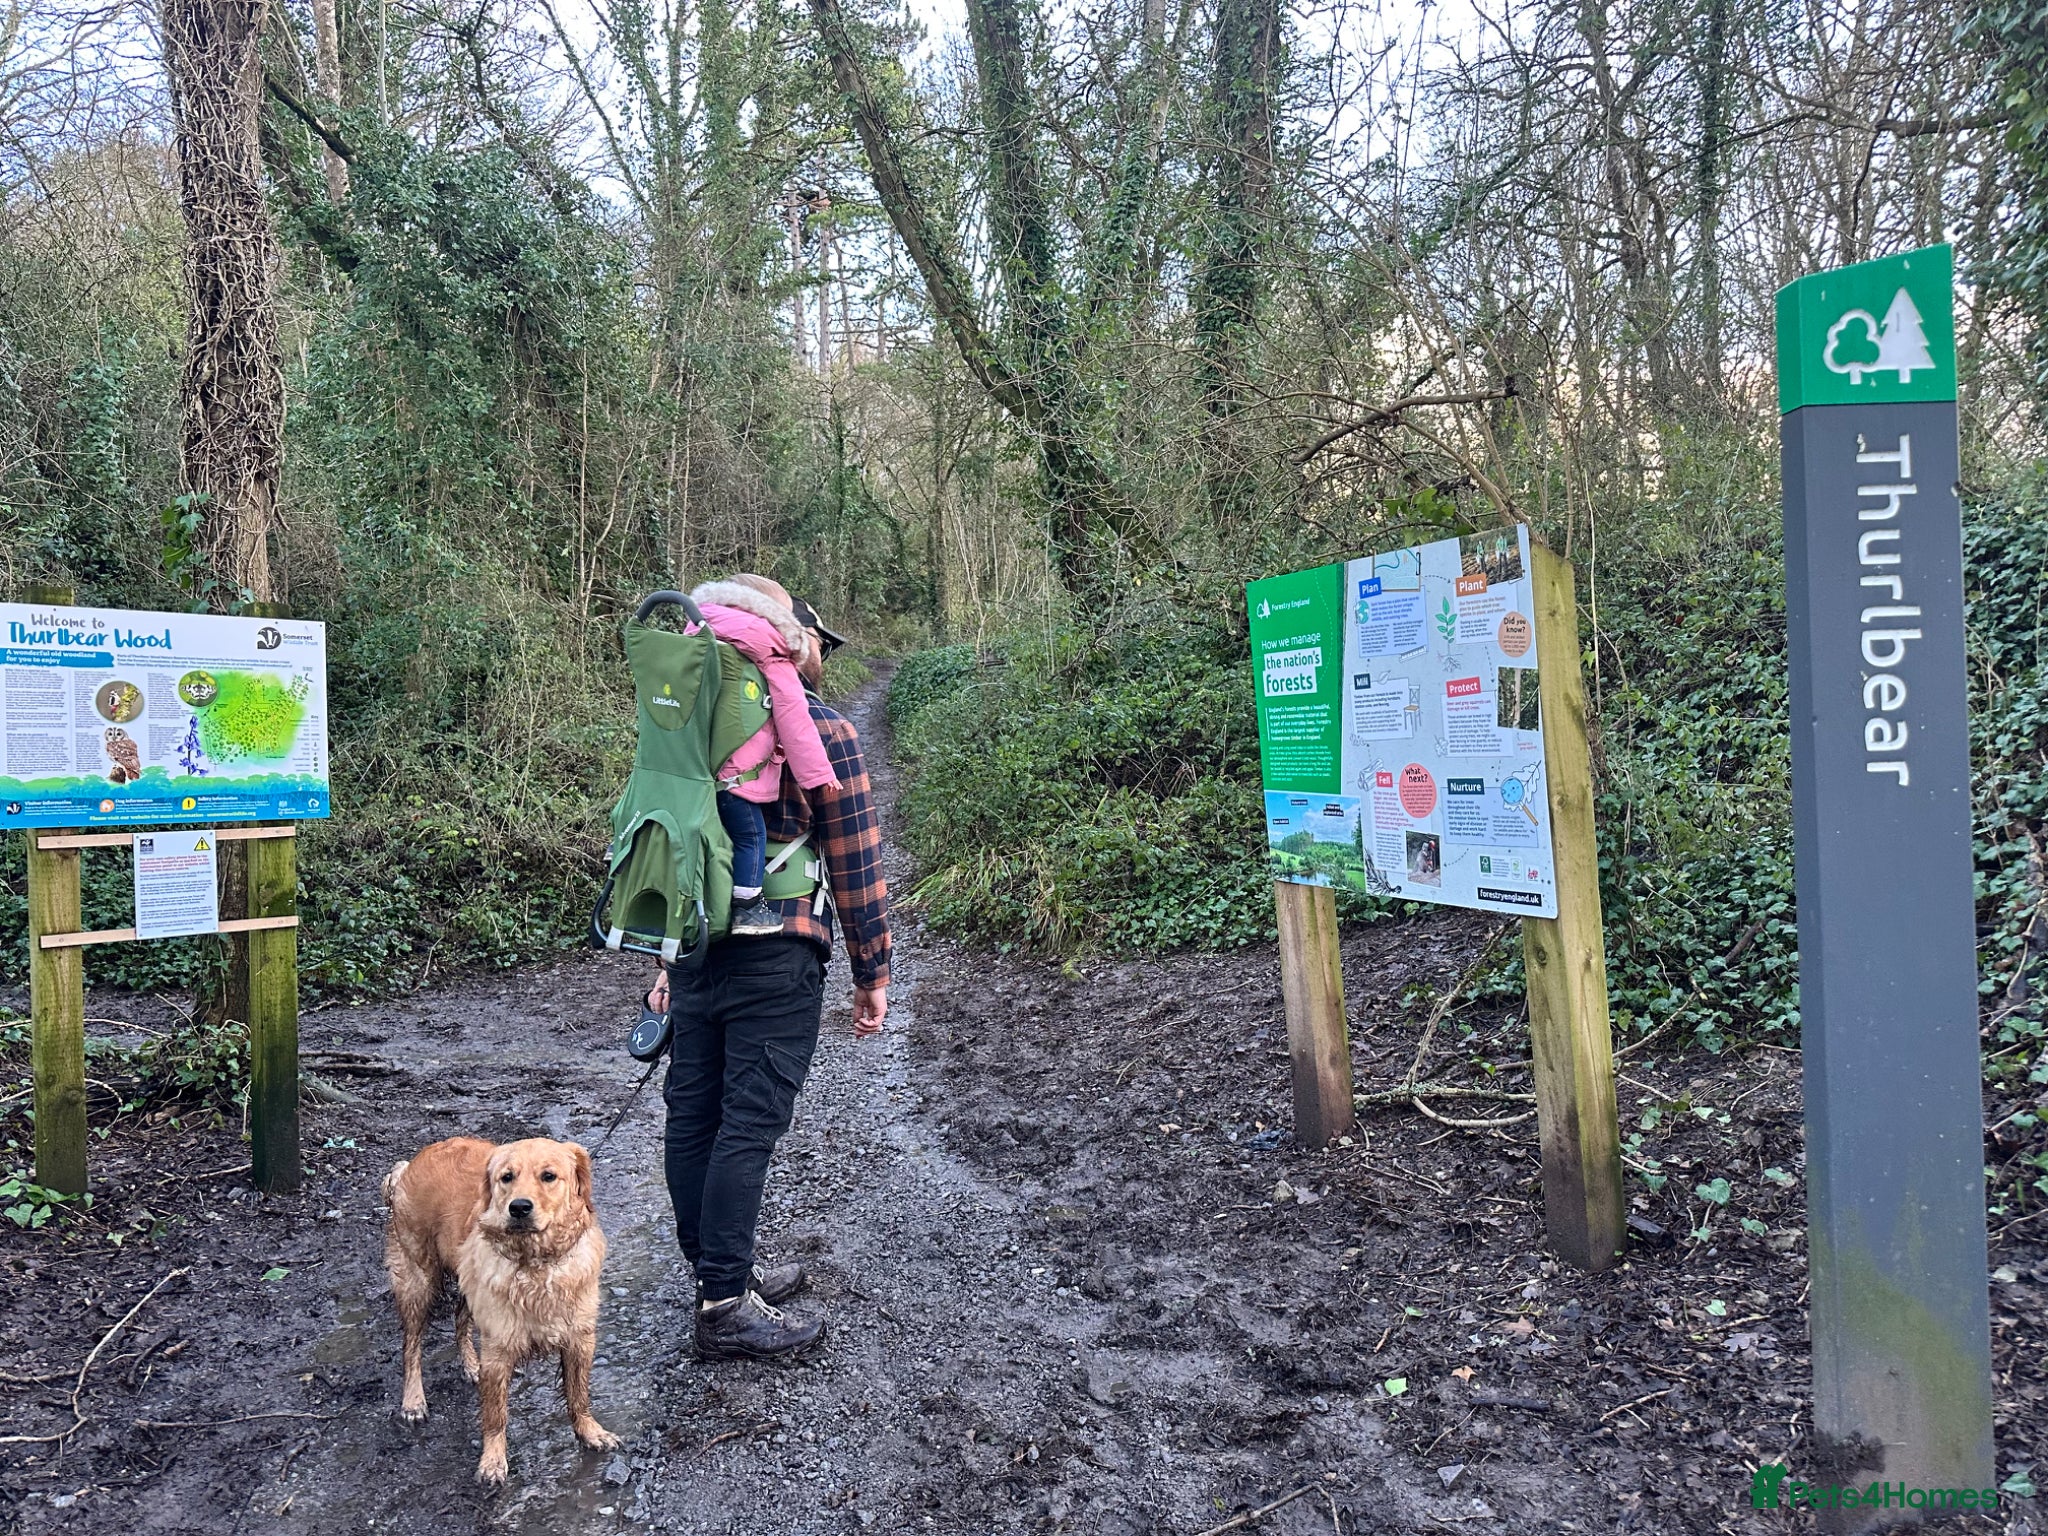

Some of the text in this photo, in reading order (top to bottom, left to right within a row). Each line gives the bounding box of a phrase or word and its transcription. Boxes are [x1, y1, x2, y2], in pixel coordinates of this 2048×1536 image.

[1362, 584, 1378, 594] Plan
[1460, 580, 1484, 592] Plant
[1272, 597, 1310, 611] Forestry England
[1855, 433, 1922, 787] Thurlbear
[31, 613, 105, 629] Welcome to
[1504, 616, 1515, 625] Did
[8, 621, 172, 649] Thurlbear Wood
[1261, 632, 1321, 650] How we manage
[1266, 650, 1320, 670] the nation's
[1266, 673, 1313, 693] forests
[1450, 682, 1478, 693] Protect
[1379, 776, 1391, 784] Fell
[1409, 774, 1428, 783] next?
[1451, 782, 1481, 791] Nurture
[1480, 889, 1539, 904] forestryengland.uk
